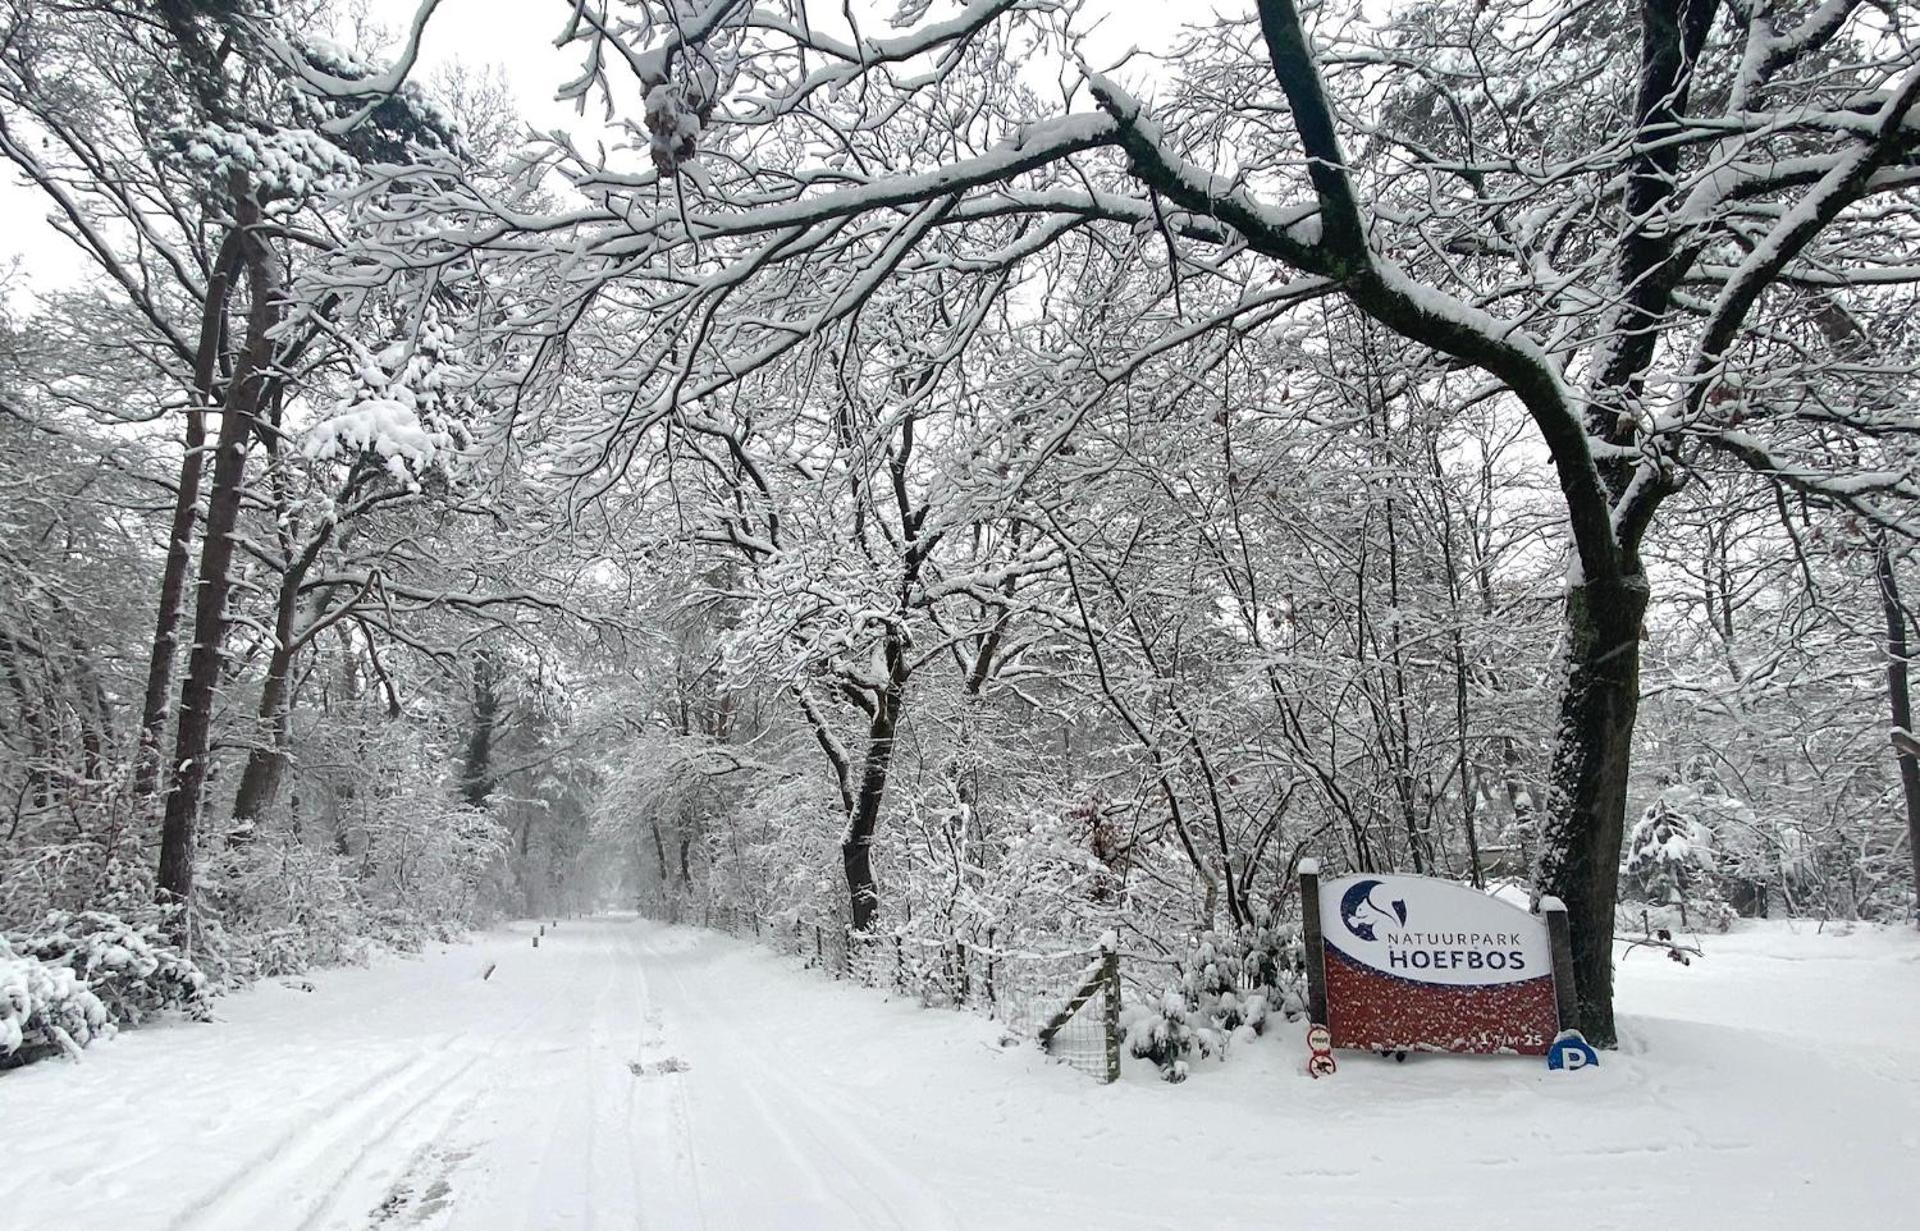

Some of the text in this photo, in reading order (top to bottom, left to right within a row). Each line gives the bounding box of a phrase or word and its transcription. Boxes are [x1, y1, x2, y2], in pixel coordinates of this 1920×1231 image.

[1388, 933, 1520, 945] NATUURPARK
[1389, 950, 1525, 969] HOEFBOS
[1524, 1035, 1543, 1046] 25
[1562, 1048, 1587, 1071] P
